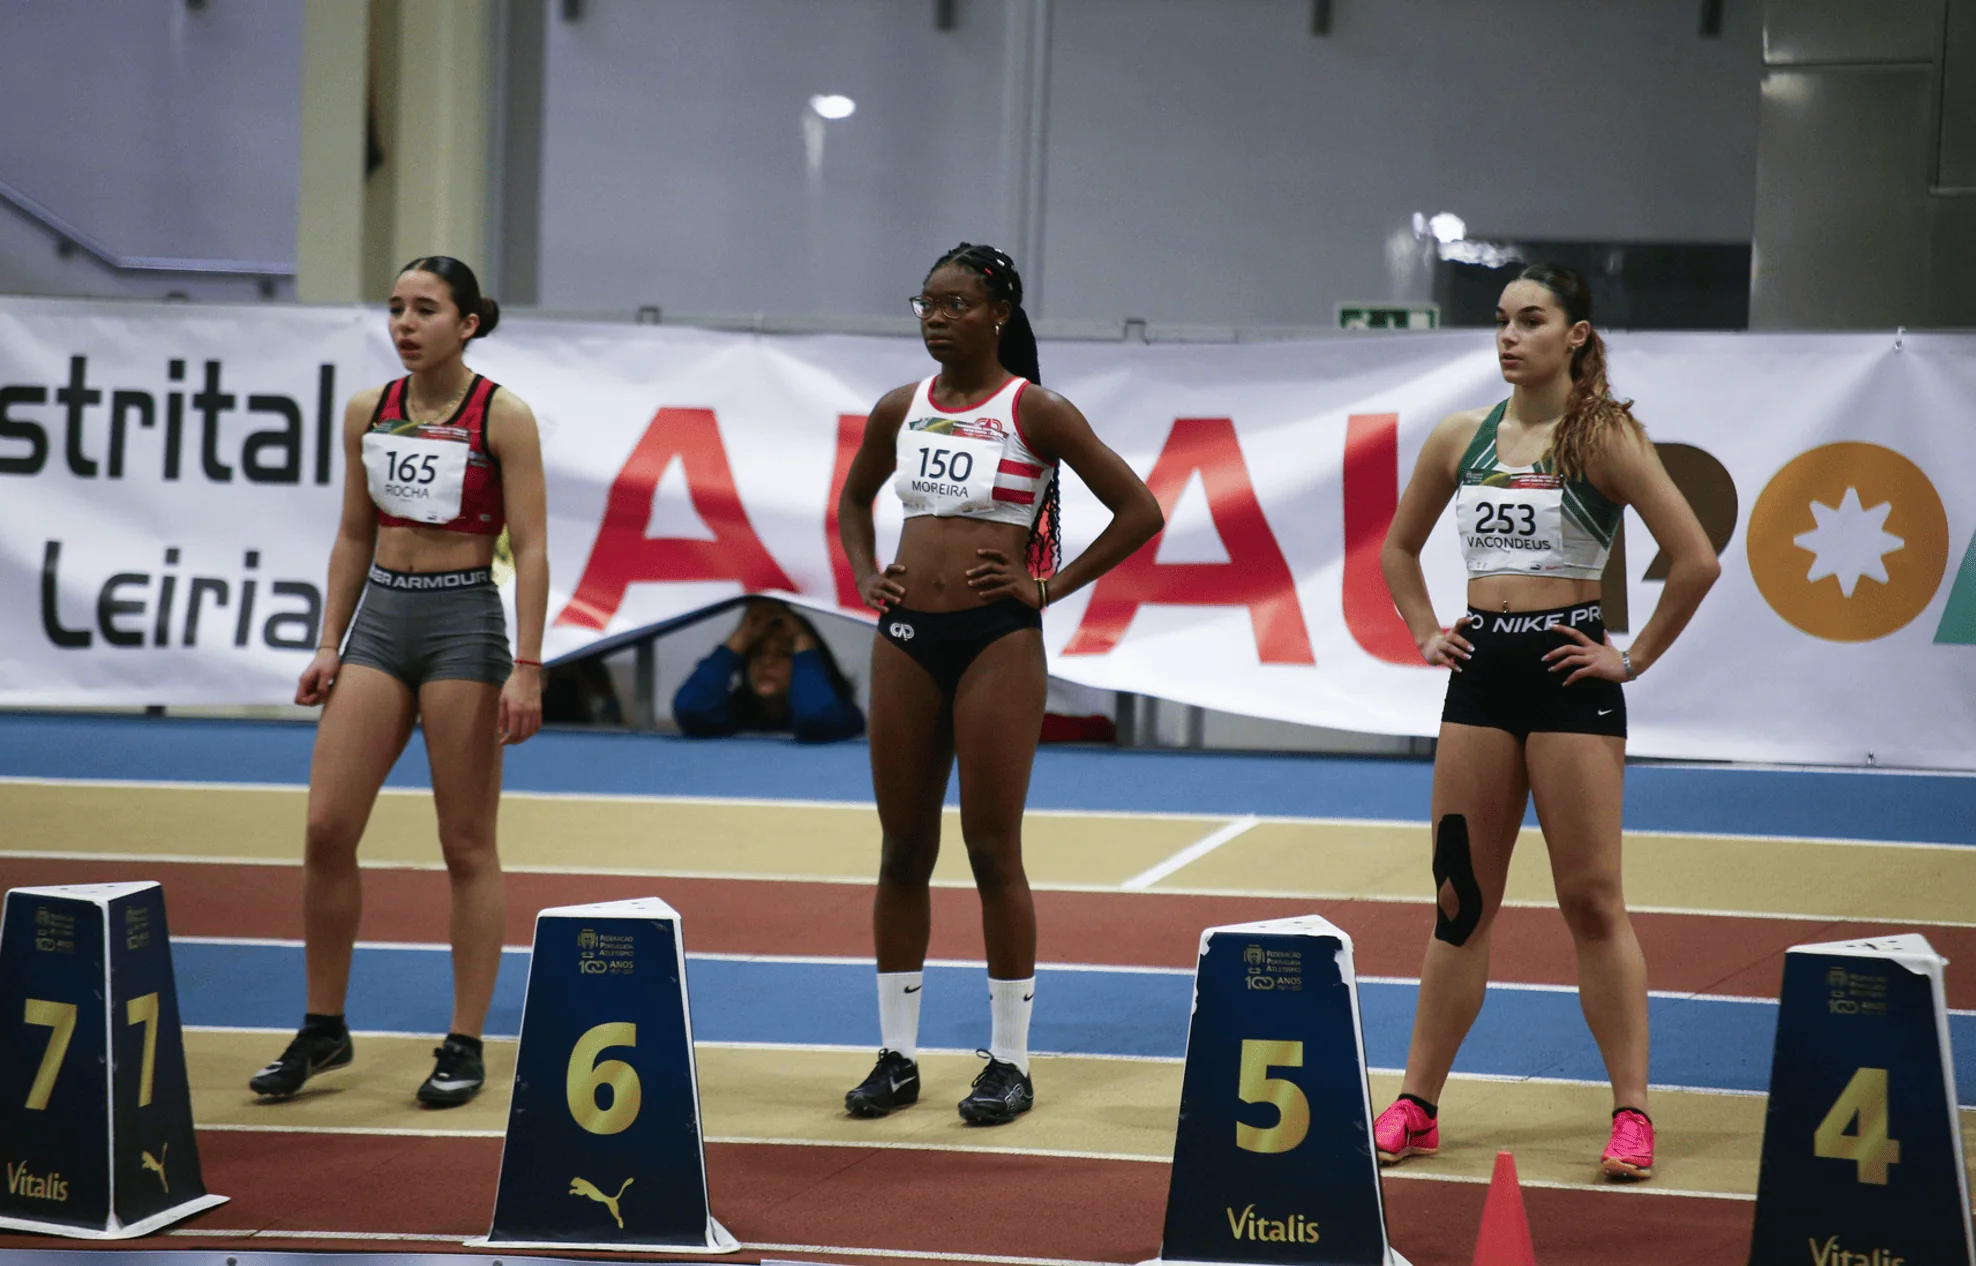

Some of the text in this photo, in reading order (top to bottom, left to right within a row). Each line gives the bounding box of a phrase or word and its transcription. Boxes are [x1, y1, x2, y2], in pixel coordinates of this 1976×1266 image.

[386, 451, 439, 485] 165
[919, 447, 973, 482] 150
[385, 484, 430, 498] ROCHA
[912, 480, 969, 498] MOREIRA
[1475, 502, 1536, 536] 253
[1467, 536, 1552, 550] VACONDEUS
[41, 541, 323, 650] Leiria
[393, 571, 487, 589] ARMOUR
[1492, 613, 1564, 633] NIKE
[609, 960, 634, 968] ANOS
[1277, 976, 1302, 985] ANOS
[24, 998, 78, 1111] 7
[126, 991, 159, 1108] 7
[566, 1021, 642, 1135] 6
[1236, 1039, 1310, 1154] 5
[1813, 1067, 1900, 1185] 4
[7, 1160, 69, 1201] Vitalis
[1226, 1203, 1319, 1243] Vitalis
